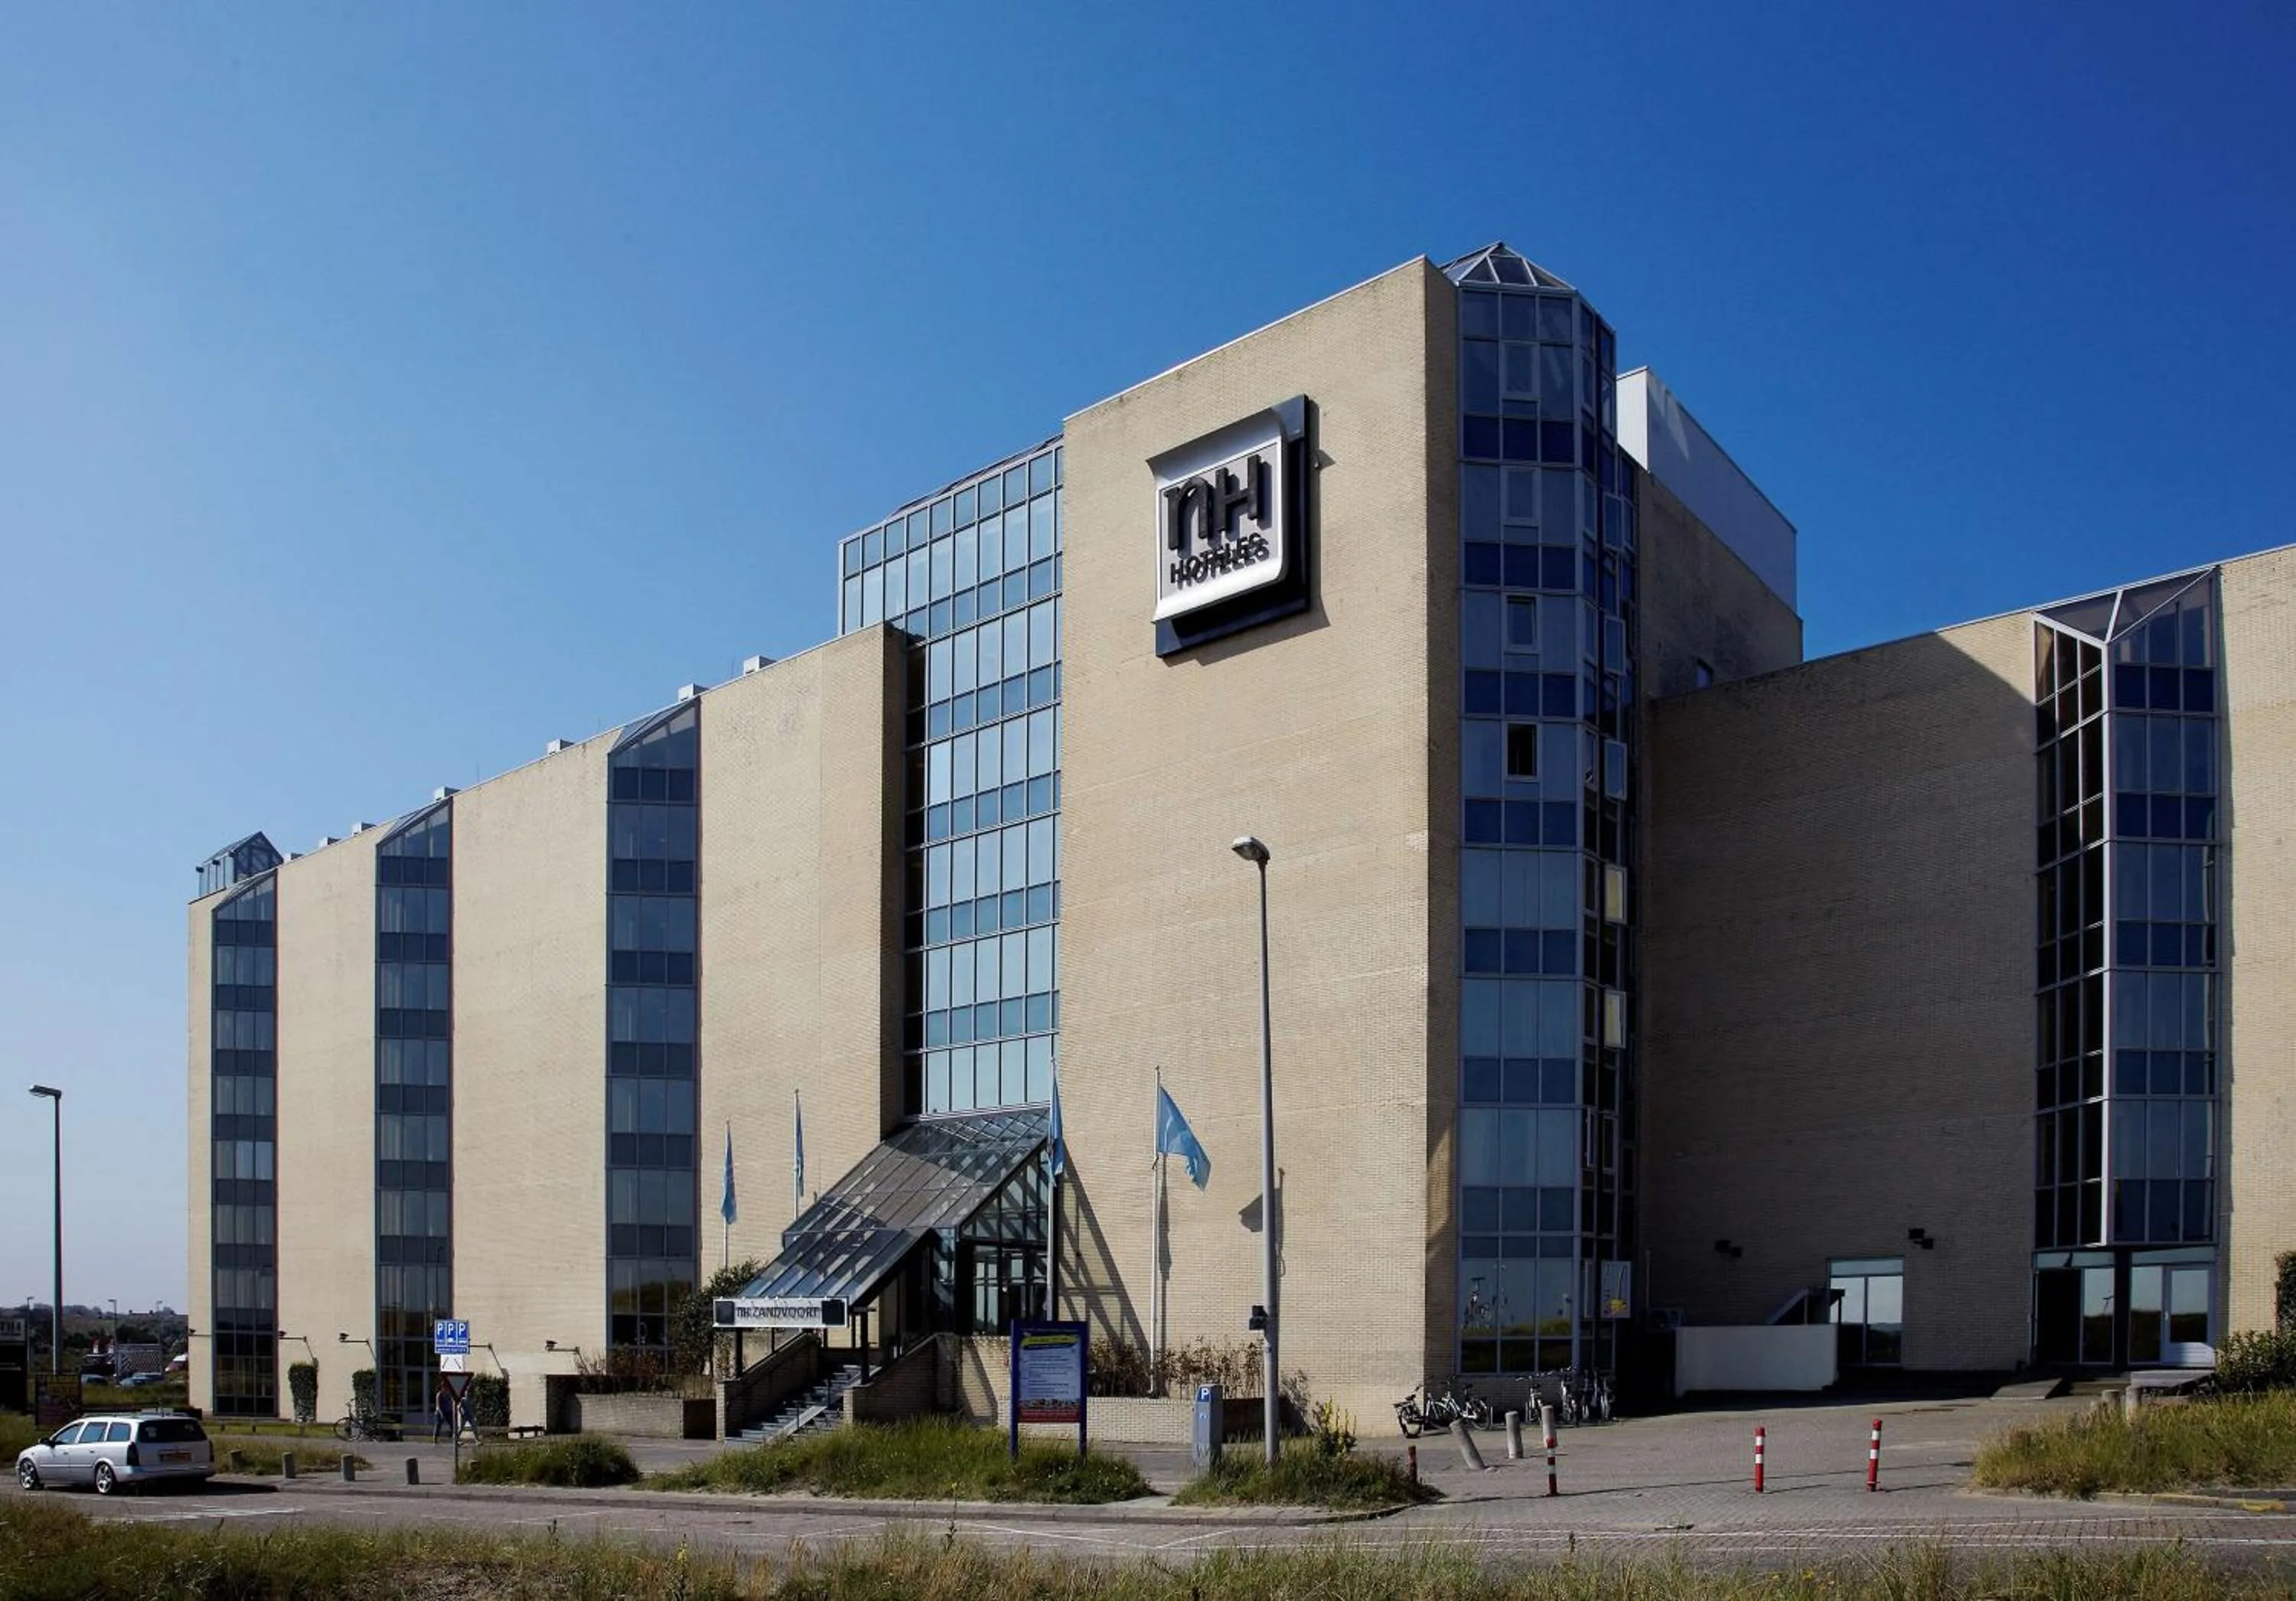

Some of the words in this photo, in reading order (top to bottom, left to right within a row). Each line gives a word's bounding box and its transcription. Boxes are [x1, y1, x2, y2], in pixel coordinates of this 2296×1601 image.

[752, 1306, 820, 1318] ZANDVOORT
[437, 1323, 443, 1335] P
[448, 1323, 454, 1335] P
[459, 1323, 466, 1335] P
[1202, 1387, 1209, 1400] P
